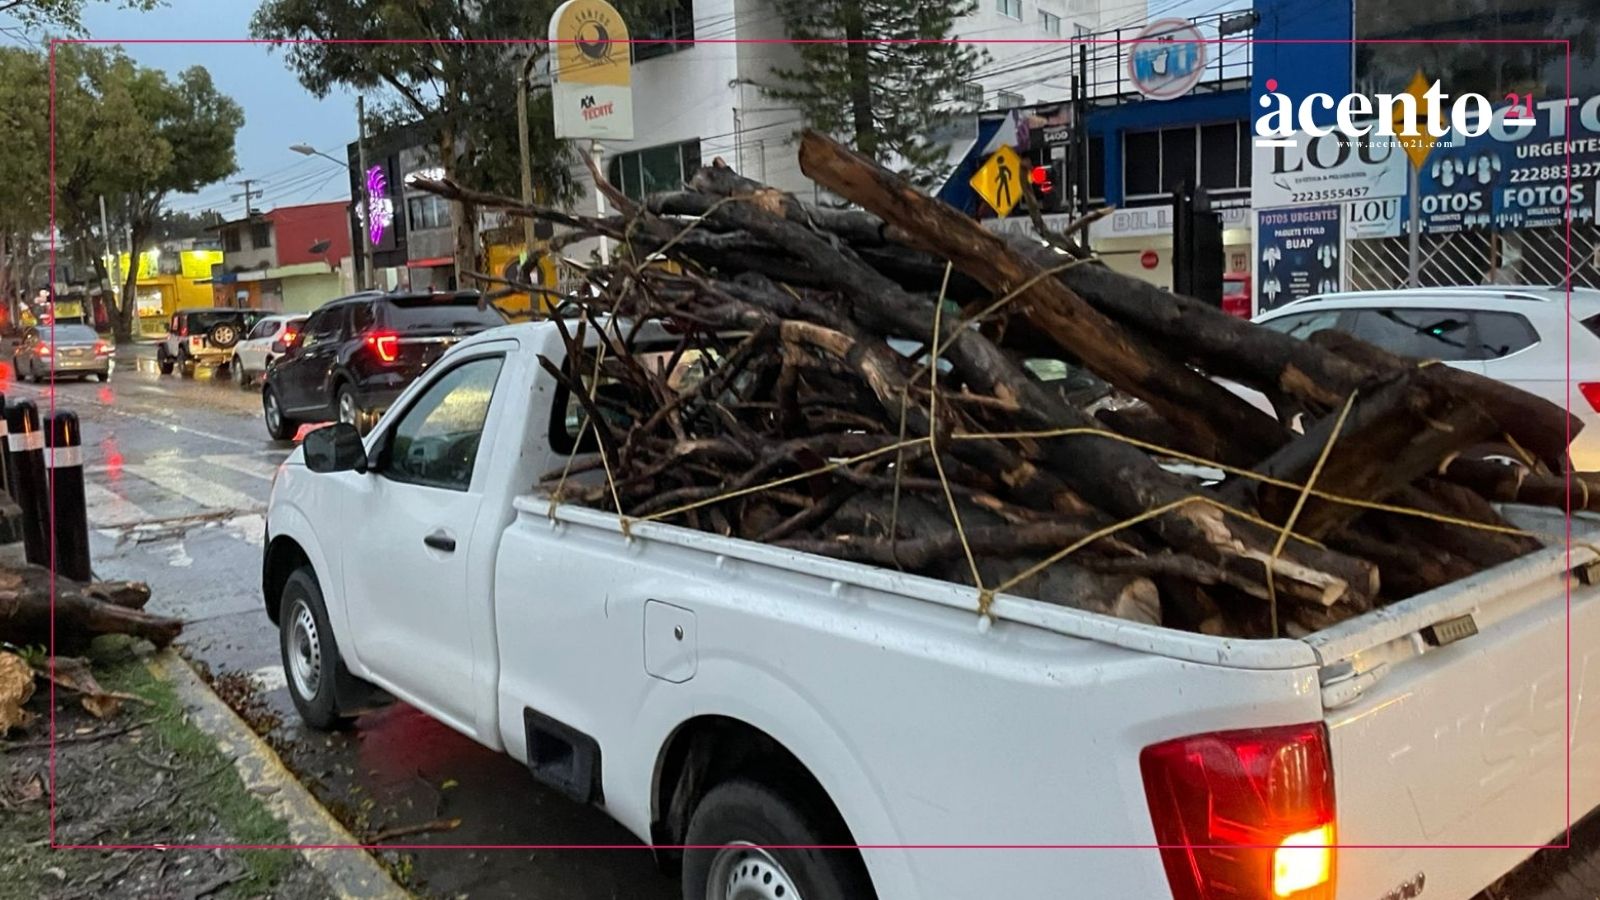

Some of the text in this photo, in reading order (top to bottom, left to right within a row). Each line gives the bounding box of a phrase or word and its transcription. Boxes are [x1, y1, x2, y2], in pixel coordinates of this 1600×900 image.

[1269, 126, 1394, 175] LOU
[1516, 138, 1600, 159] URGENTE
[1292, 186, 1370, 203] 2223555457
[1418, 191, 1483, 214] OTOS
[1503, 184, 1585, 209] FOTOS
[1261, 213, 1289, 225] FOTOS
[1290, 209, 1338, 223] URGENTES
[1351, 200, 1396, 222] LOU
[1285, 239, 1314, 250] BUAP
